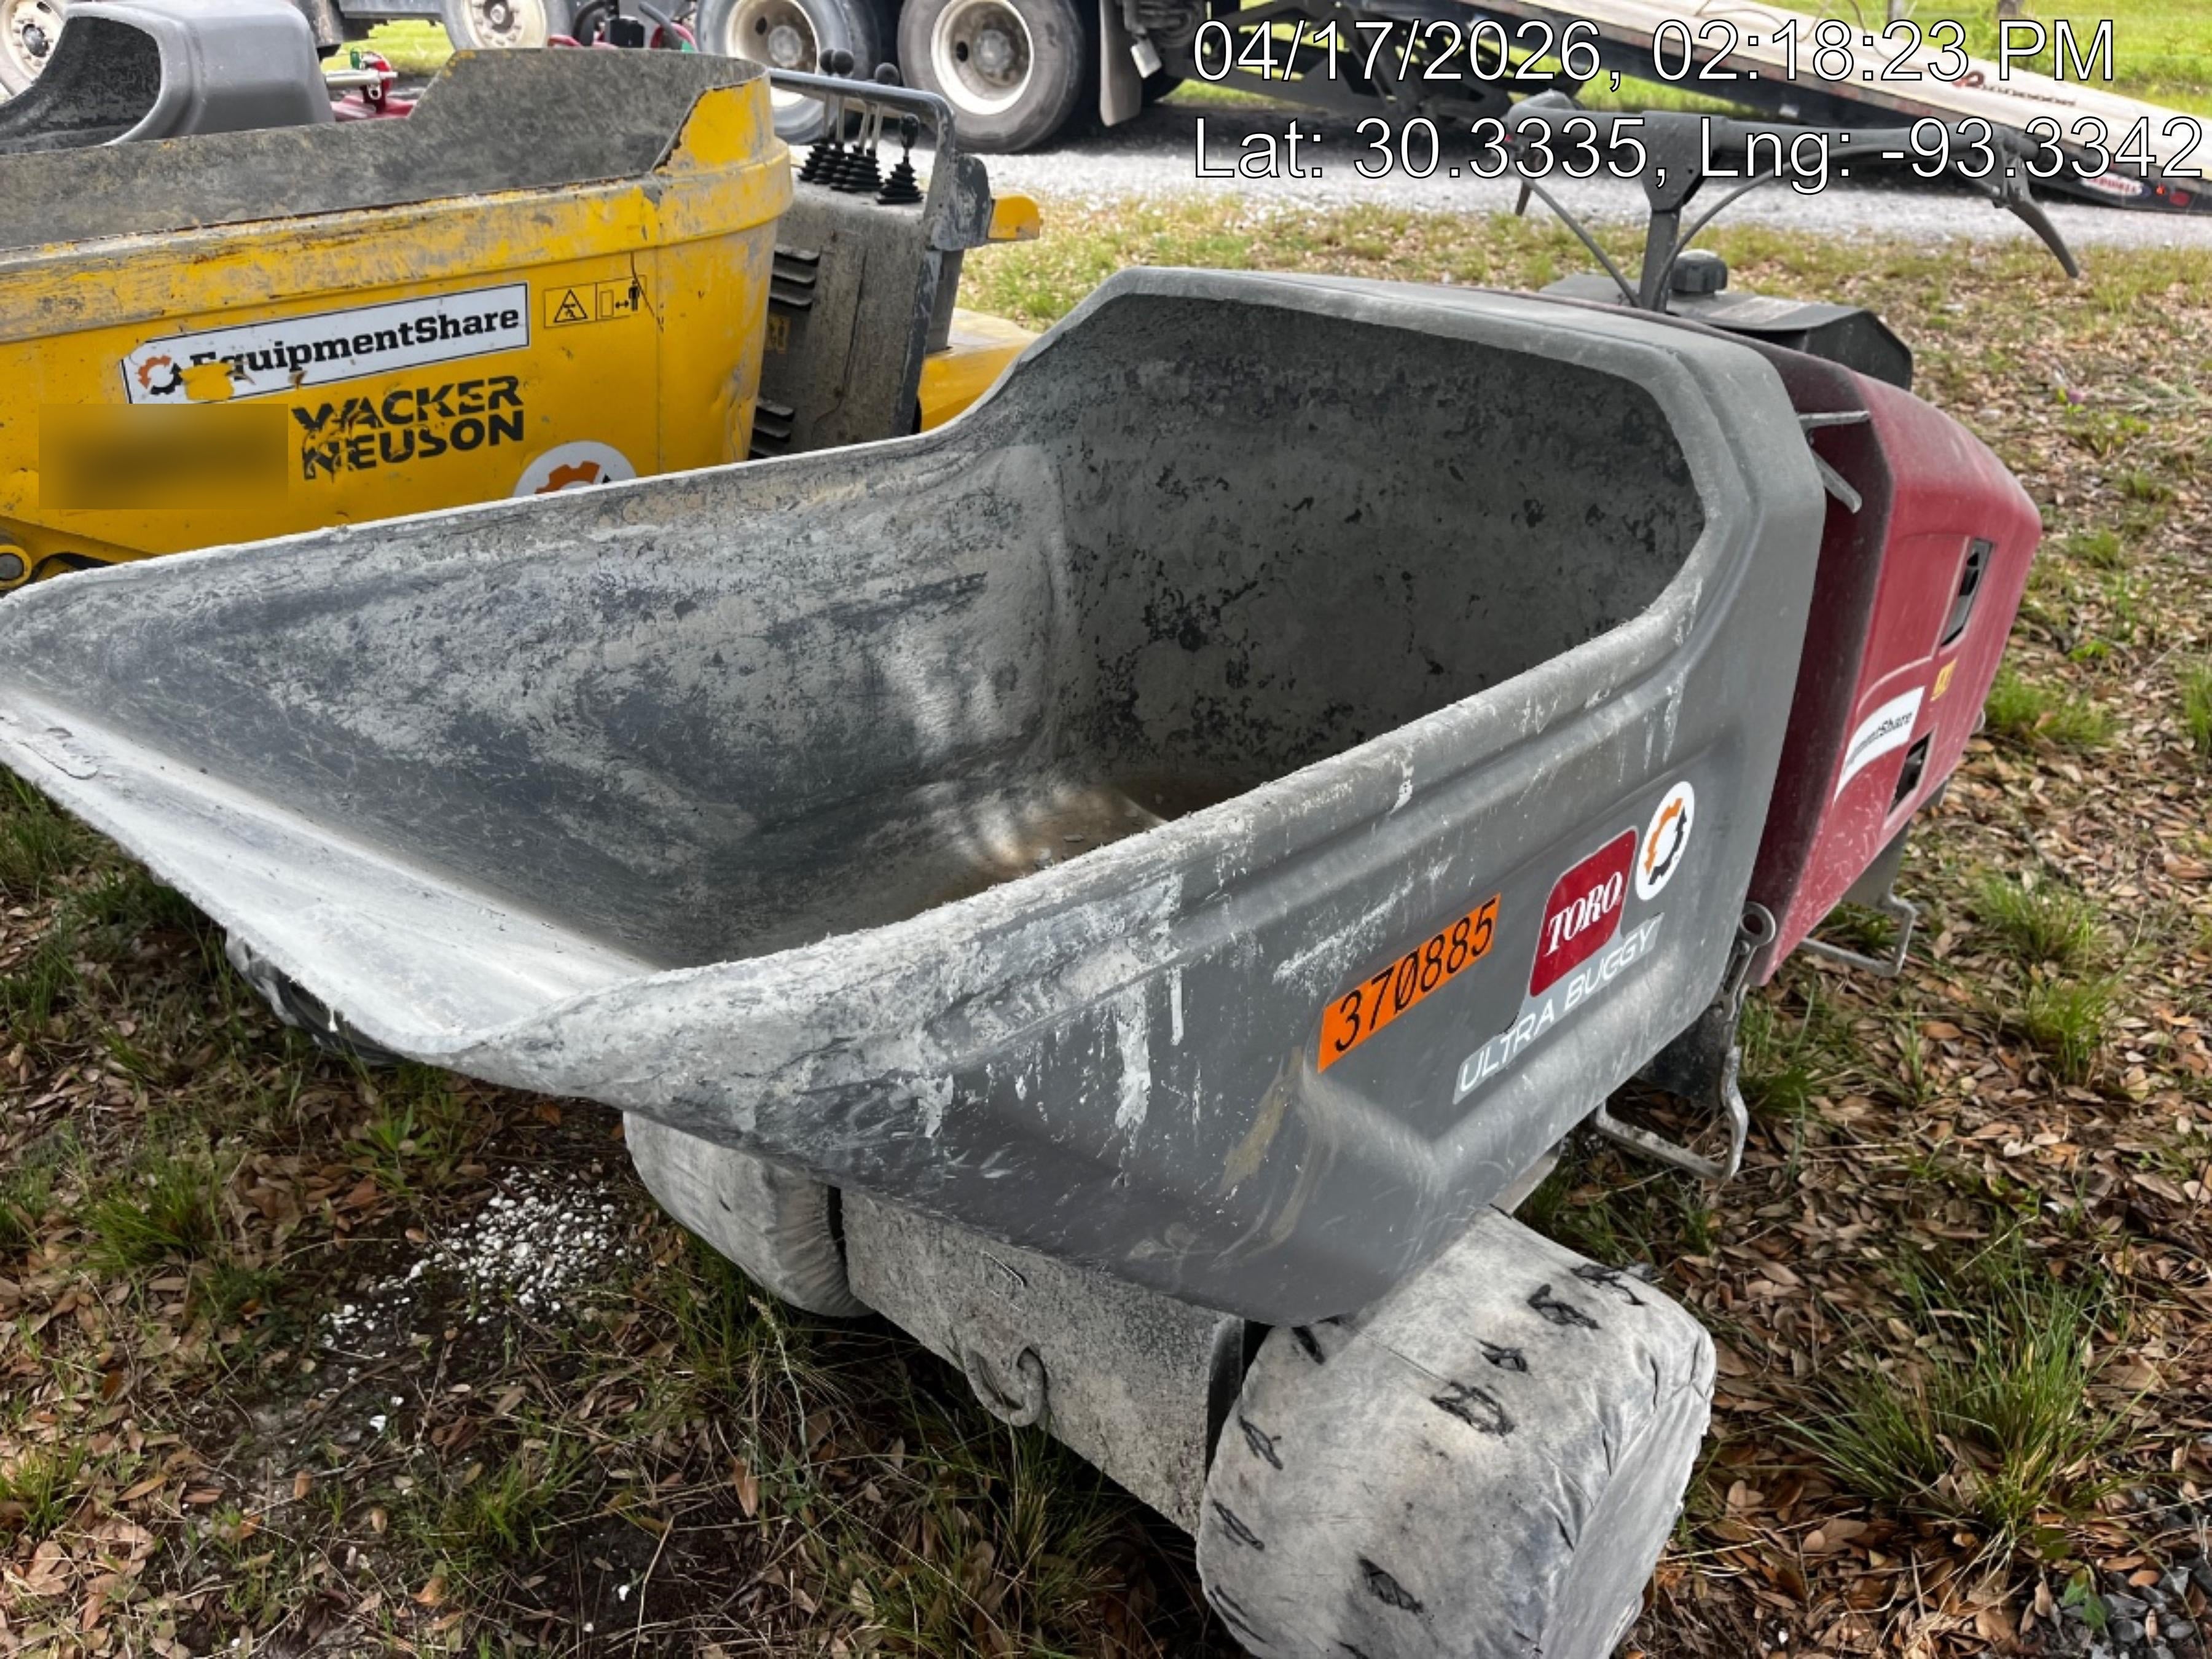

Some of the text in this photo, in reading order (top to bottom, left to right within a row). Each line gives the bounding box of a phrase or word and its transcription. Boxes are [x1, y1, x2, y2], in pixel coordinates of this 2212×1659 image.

[291, 375, 524, 431] WACKER
[302, 410, 525, 480] NEUSON
[1545, 871, 1623, 956] TORO
[1335, 898, 1497, 1052] 370885
[1459, 922, 1658, 1093] ULTRA BUGGY
